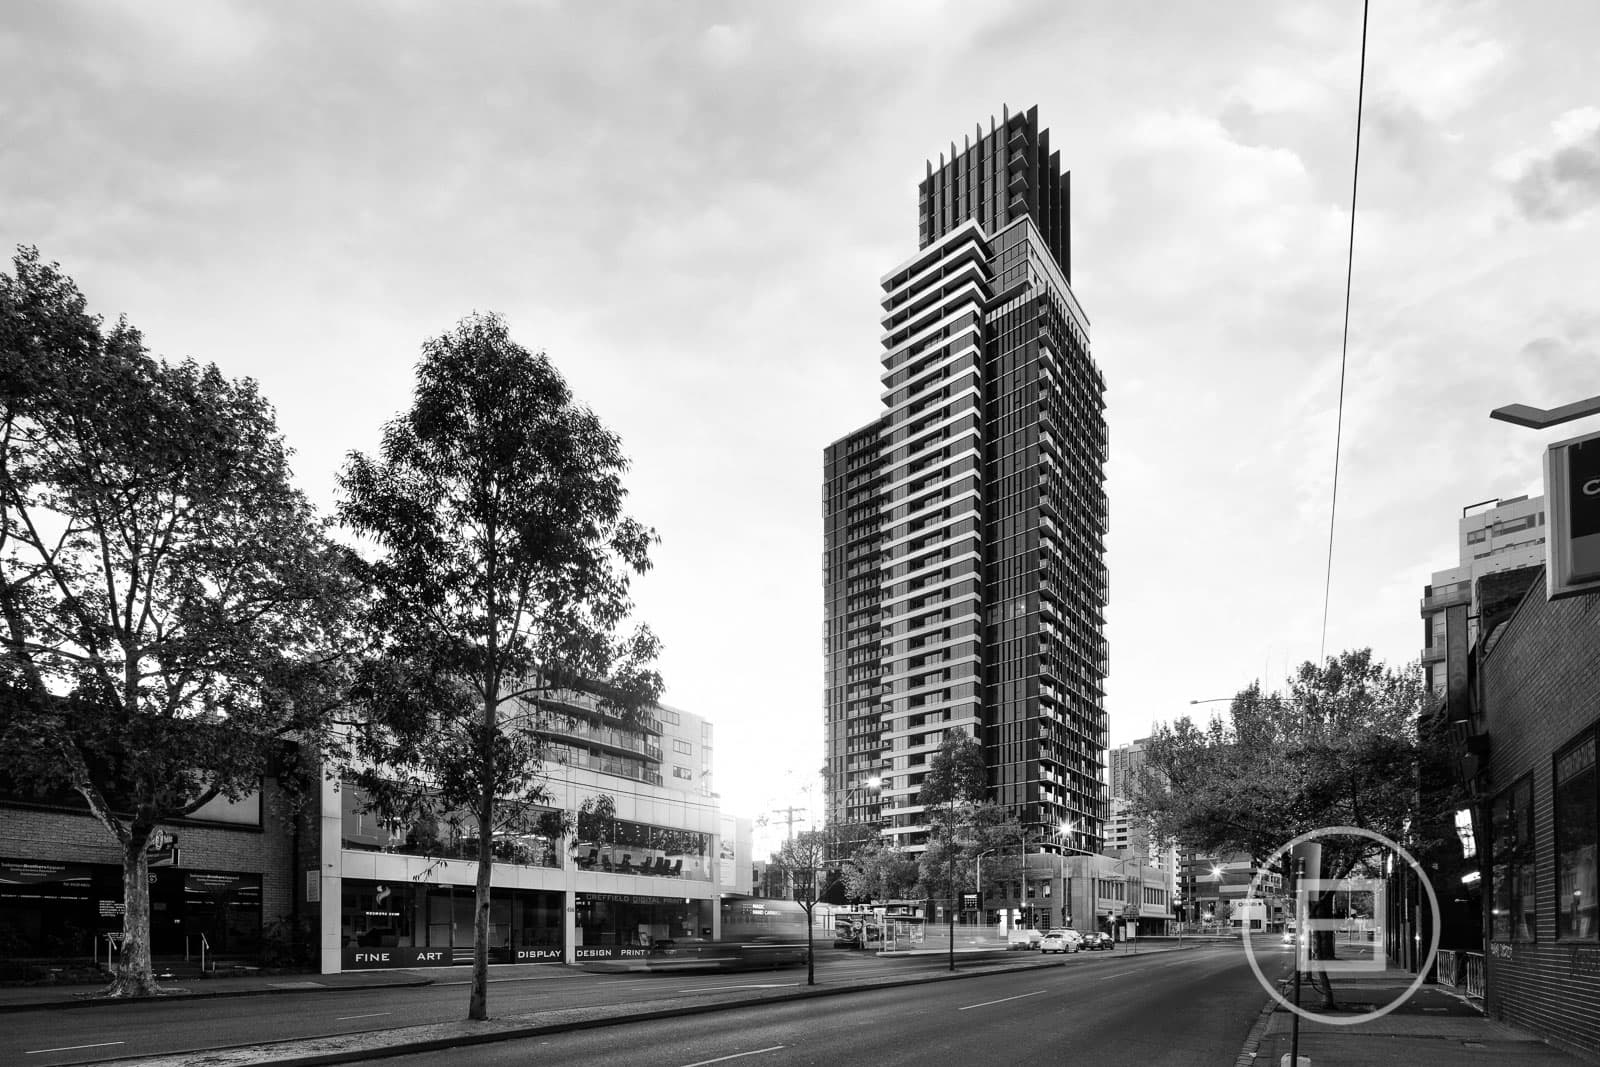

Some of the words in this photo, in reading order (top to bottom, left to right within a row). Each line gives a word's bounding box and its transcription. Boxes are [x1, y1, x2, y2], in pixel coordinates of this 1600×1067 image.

[355, 952, 390, 963] FINE
[416, 952, 443, 961] ART
[517, 949, 562, 959] DISPLAY
[576, 949, 612, 957] DESIGN
